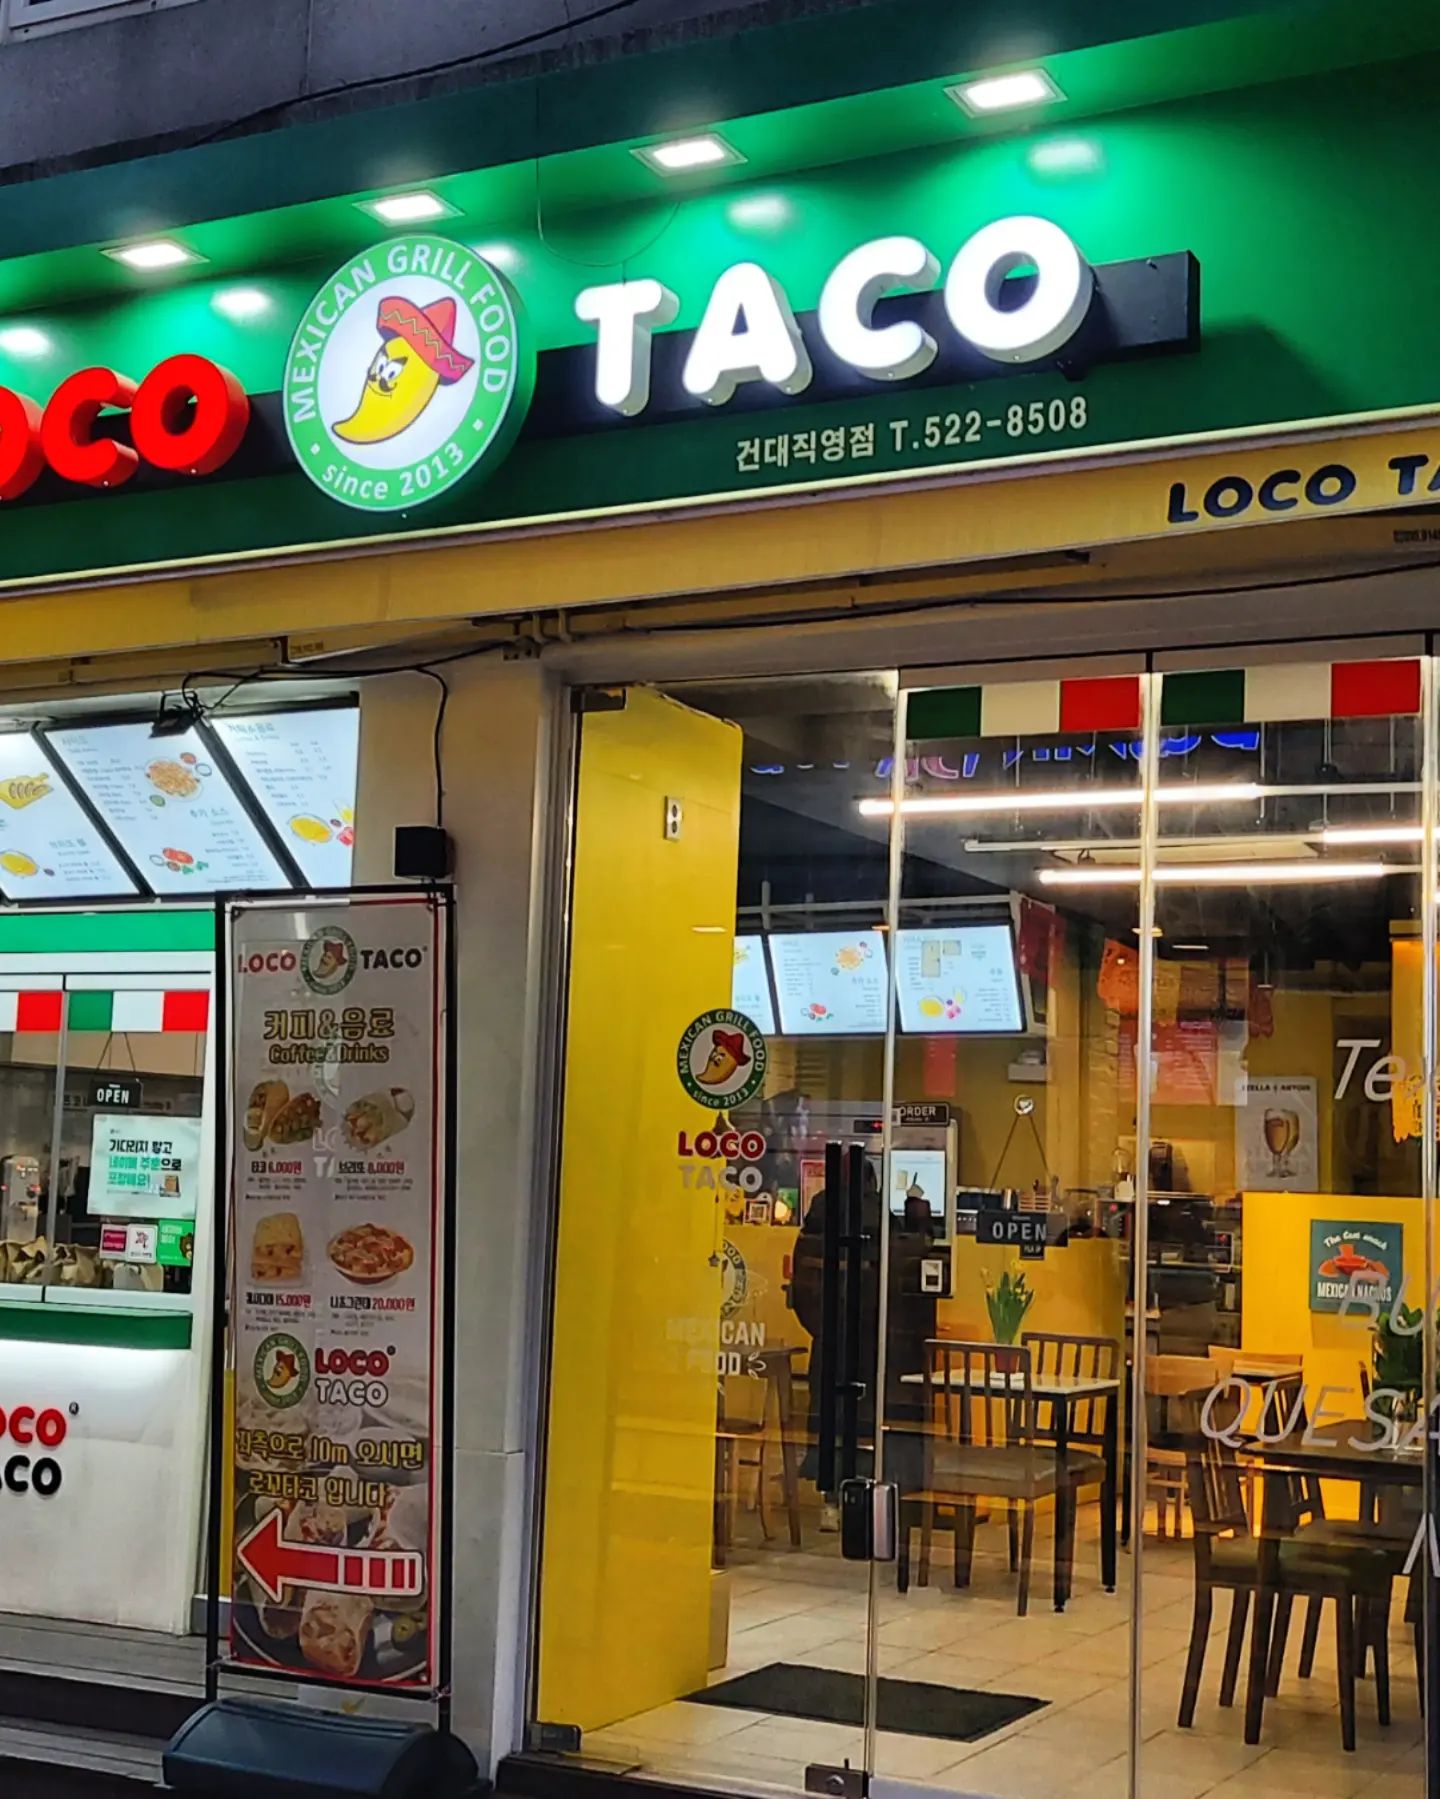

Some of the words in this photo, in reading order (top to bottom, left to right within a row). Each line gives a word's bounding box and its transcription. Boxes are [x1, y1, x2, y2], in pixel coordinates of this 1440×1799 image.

[575, 214, 1090, 415] TACO
[290, 258, 376, 424] MEXICAN
[387, 243, 471, 292] GRILL
[467, 284, 512, 394] FOOD
[735, 422, 875, 473] 건대직영점
[889, 396, 1088, 454] T.522-8508
[321, 460, 390, 500] since
[399, 443, 466, 498] 2013
[1167, 463, 1357, 524] LOCO
[237, 951, 297, 974] LOCO
[360, 948, 422, 970] TACO
[679, 1014, 712, 1074] MEXICAN
[715, 1011, 751, 1031] GRILL
[749, 1031, 765, 1072] FOOD
[97, 1088, 130, 1104] OPEN
[899, 1106, 936, 1117] ORDER
[677, 1129, 766, 1162] LOCO
[678, 1164, 764, 1193] TACO
[992, 1221, 1047, 1241] OPEN
[315, 1347, 389, 1377] LOCO
[314, 1377, 389, 1408] TACO
[0, 1406, 67, 1447] CO
[310, 1435, 350, 1465] 10m
[356, 1438, 425, 1470] 오시면
[0, 1454, 63, 1496] CO
[325, 1476, 387, 1508] 입니다
